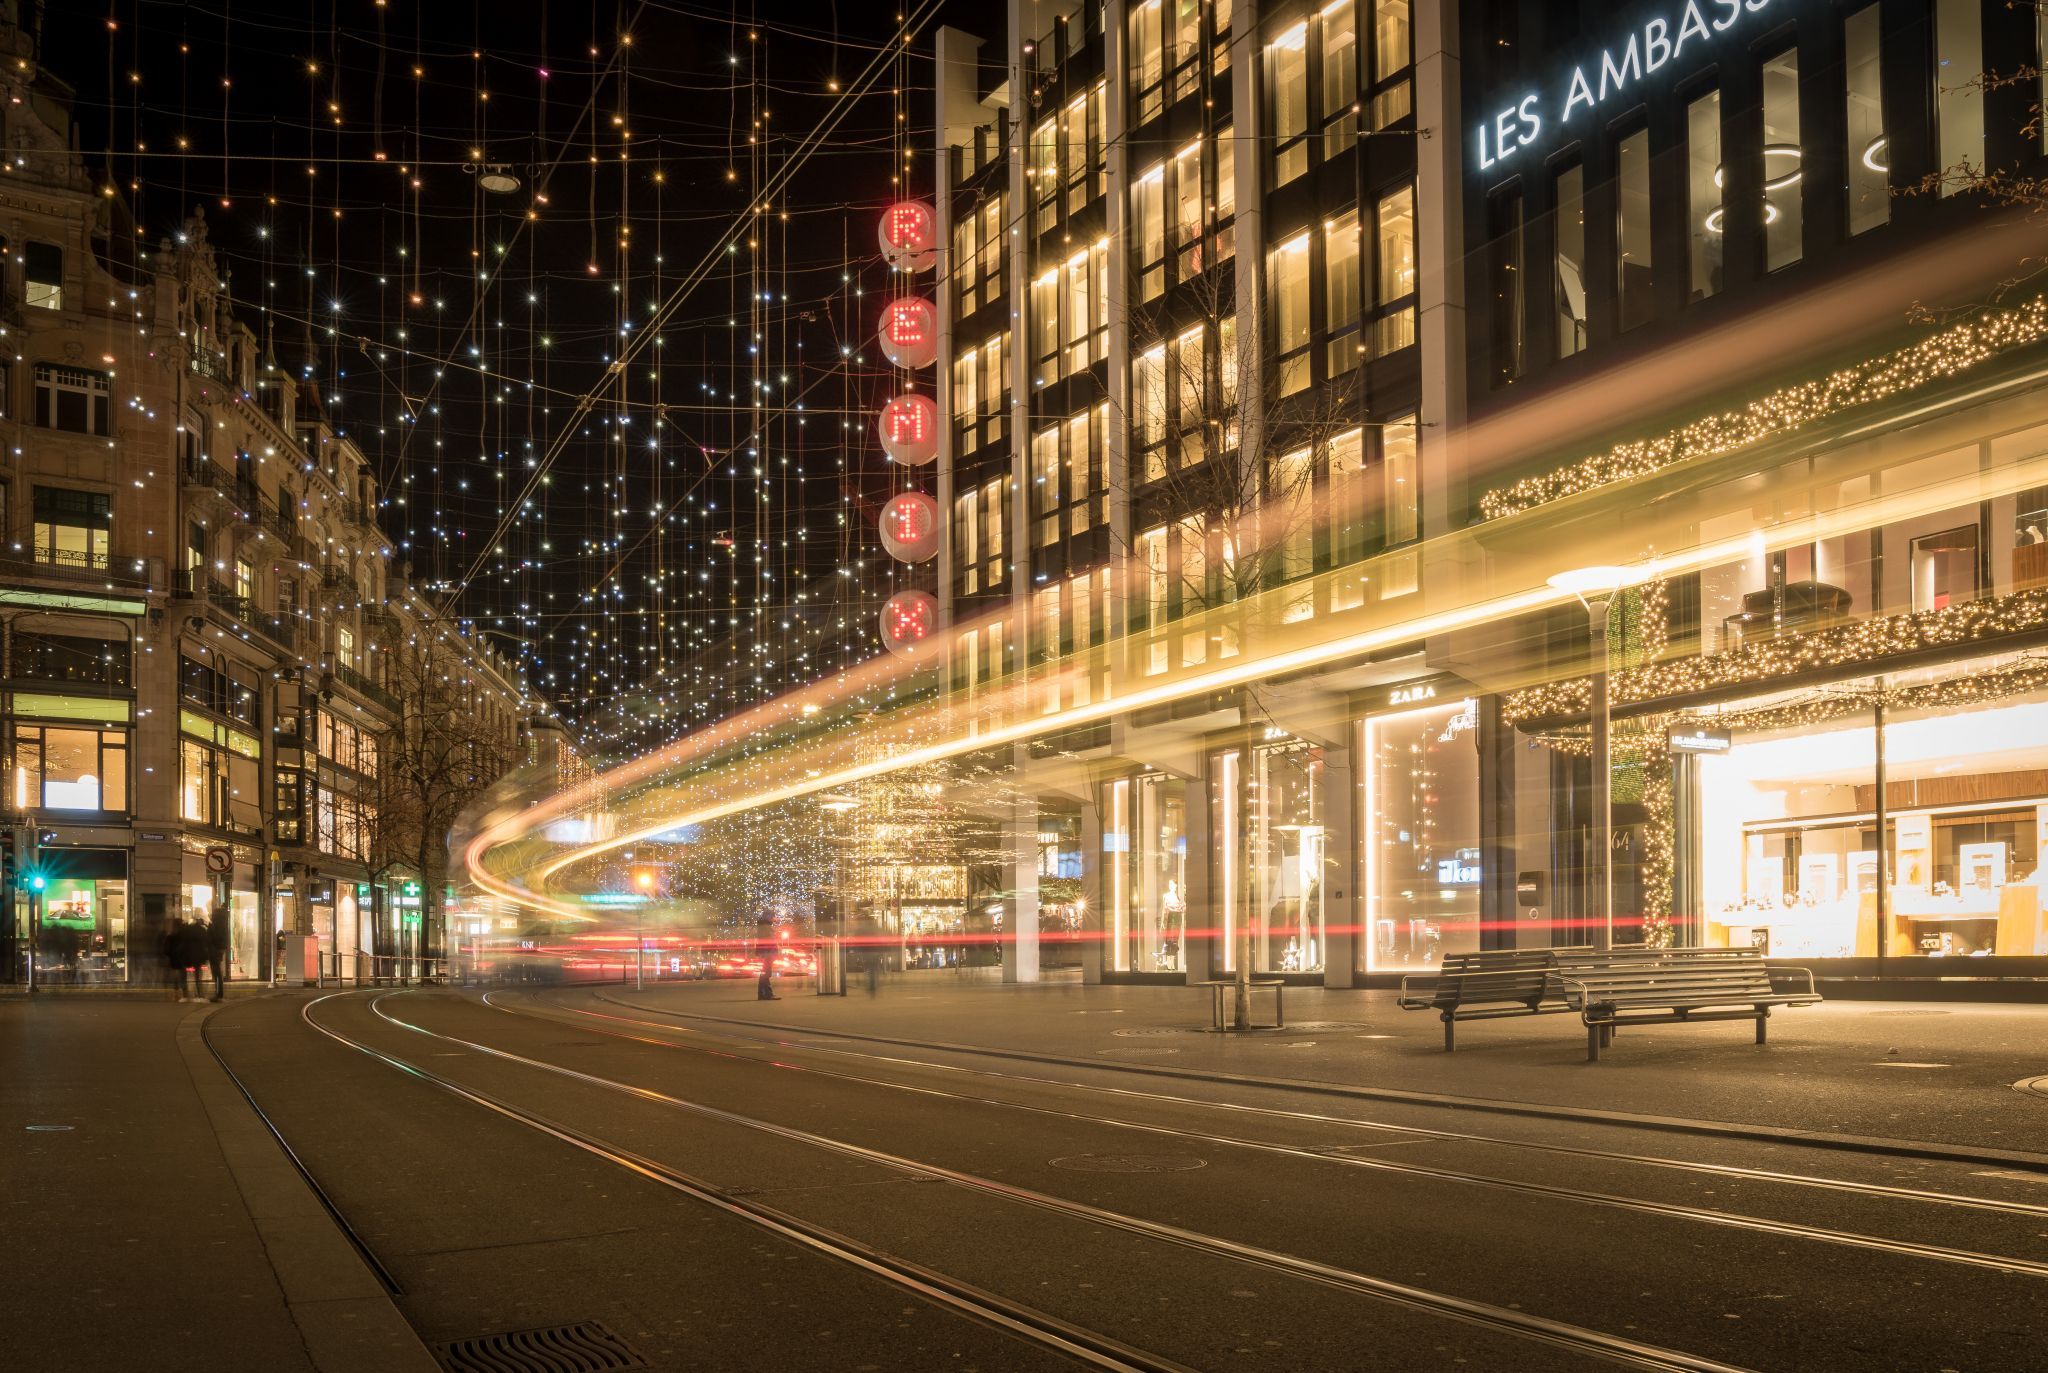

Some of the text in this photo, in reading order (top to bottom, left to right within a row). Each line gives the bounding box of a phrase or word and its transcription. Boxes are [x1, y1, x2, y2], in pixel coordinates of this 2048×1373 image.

[1479, 0, 1769, 170] LES AMBAS
[1389, 686, 1436, 705] ZARA
[1611, 830, 1630, 851] 64
